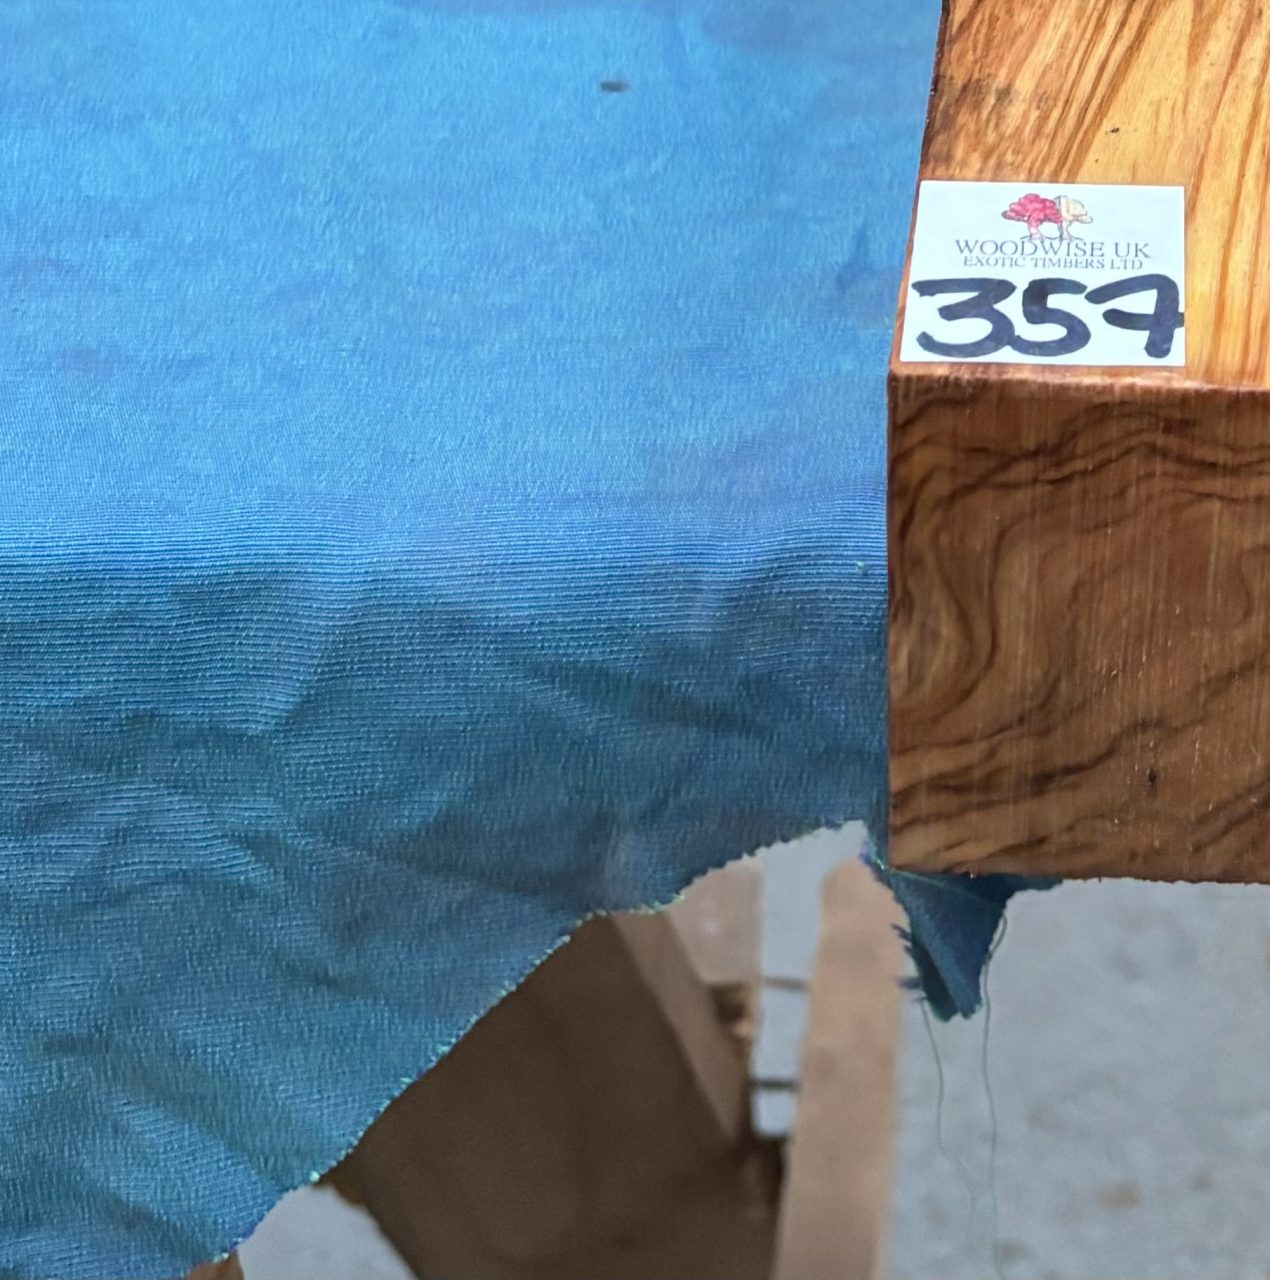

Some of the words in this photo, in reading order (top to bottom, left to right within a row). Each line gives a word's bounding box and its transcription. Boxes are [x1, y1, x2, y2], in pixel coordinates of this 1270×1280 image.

[955, 239, 1105, 257] WOODWISE
[1114, 241, 1152, 259] UK
[963, 255, 1026, 268] EXOTIC
[1030, 257, 1105, 269] TIMBERS
[1110, 258, 1143, 270] LTD
